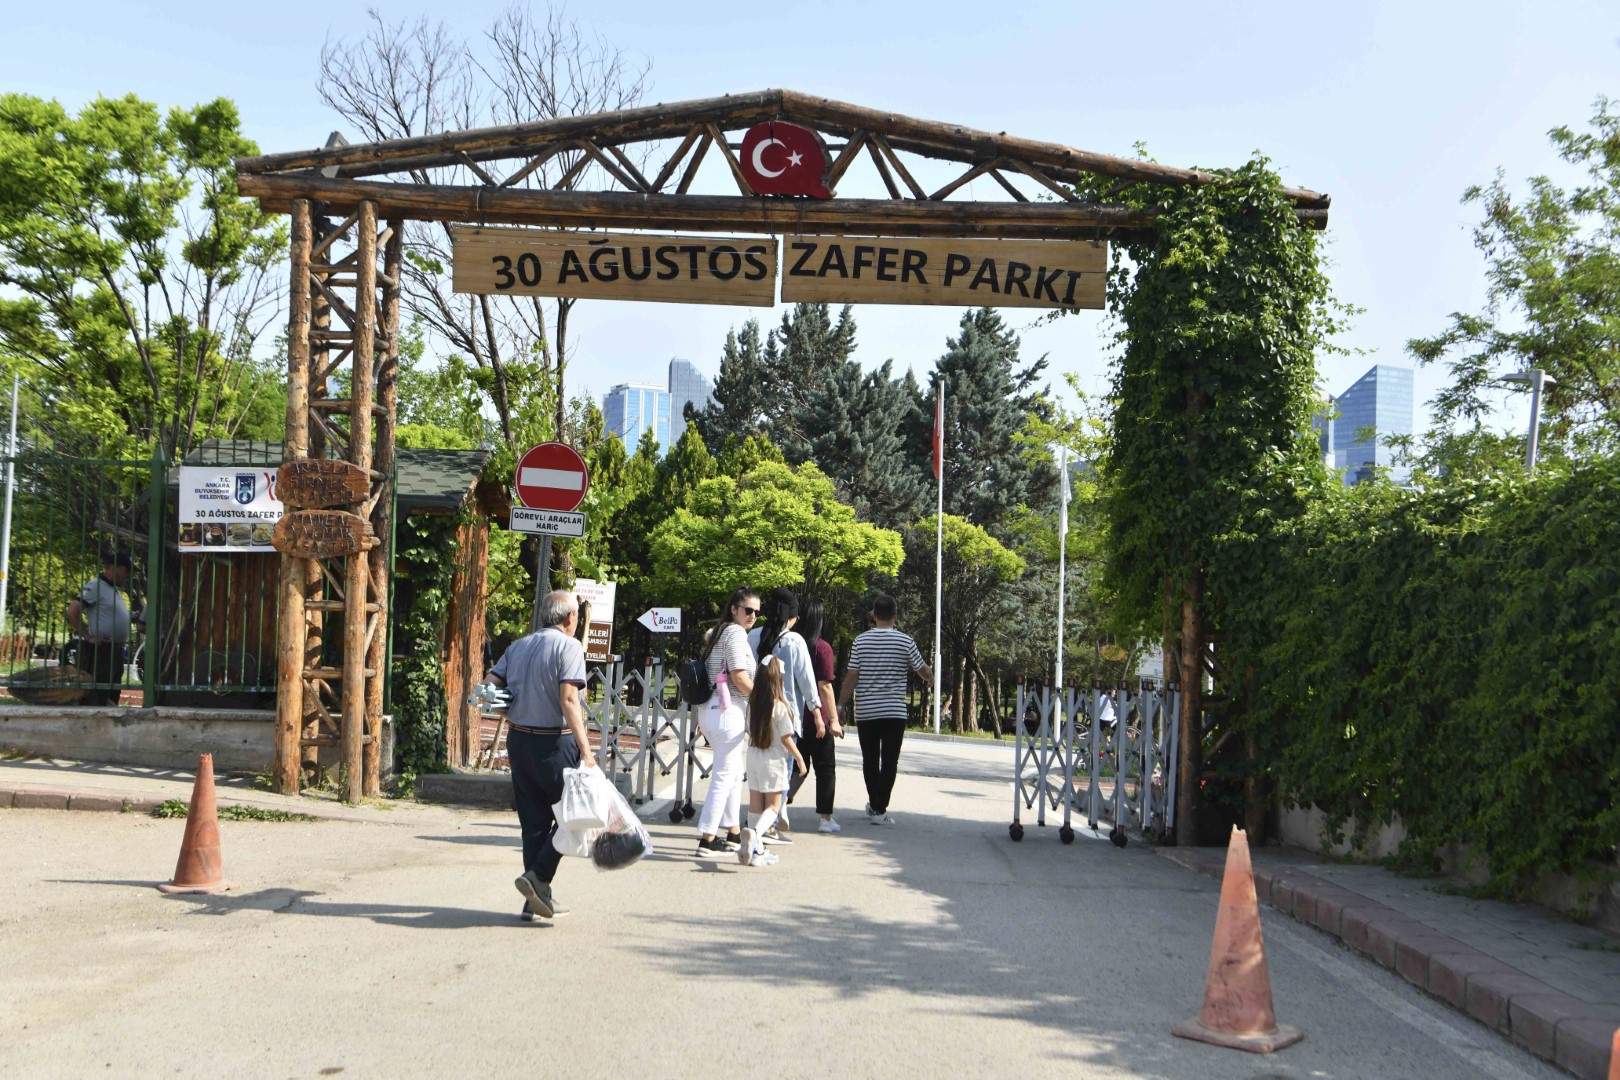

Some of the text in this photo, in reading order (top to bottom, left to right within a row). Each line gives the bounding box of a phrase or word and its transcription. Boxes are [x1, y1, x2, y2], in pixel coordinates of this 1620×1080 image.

[491, 238, 1082, 306] 30 AĞUSTOS ZAFER PARKI
[195, 510, 206, 518] 30
[208, 508, 245, 518] AĞUSTOS
[247, 510, 275, 519] ZAFER
[514, 511, 582, 525] GÖREVLİ ARAÇLAR
[536, 522, 559, 532] HARİÇ
[588, 628, 609, 637] EKLERİ
